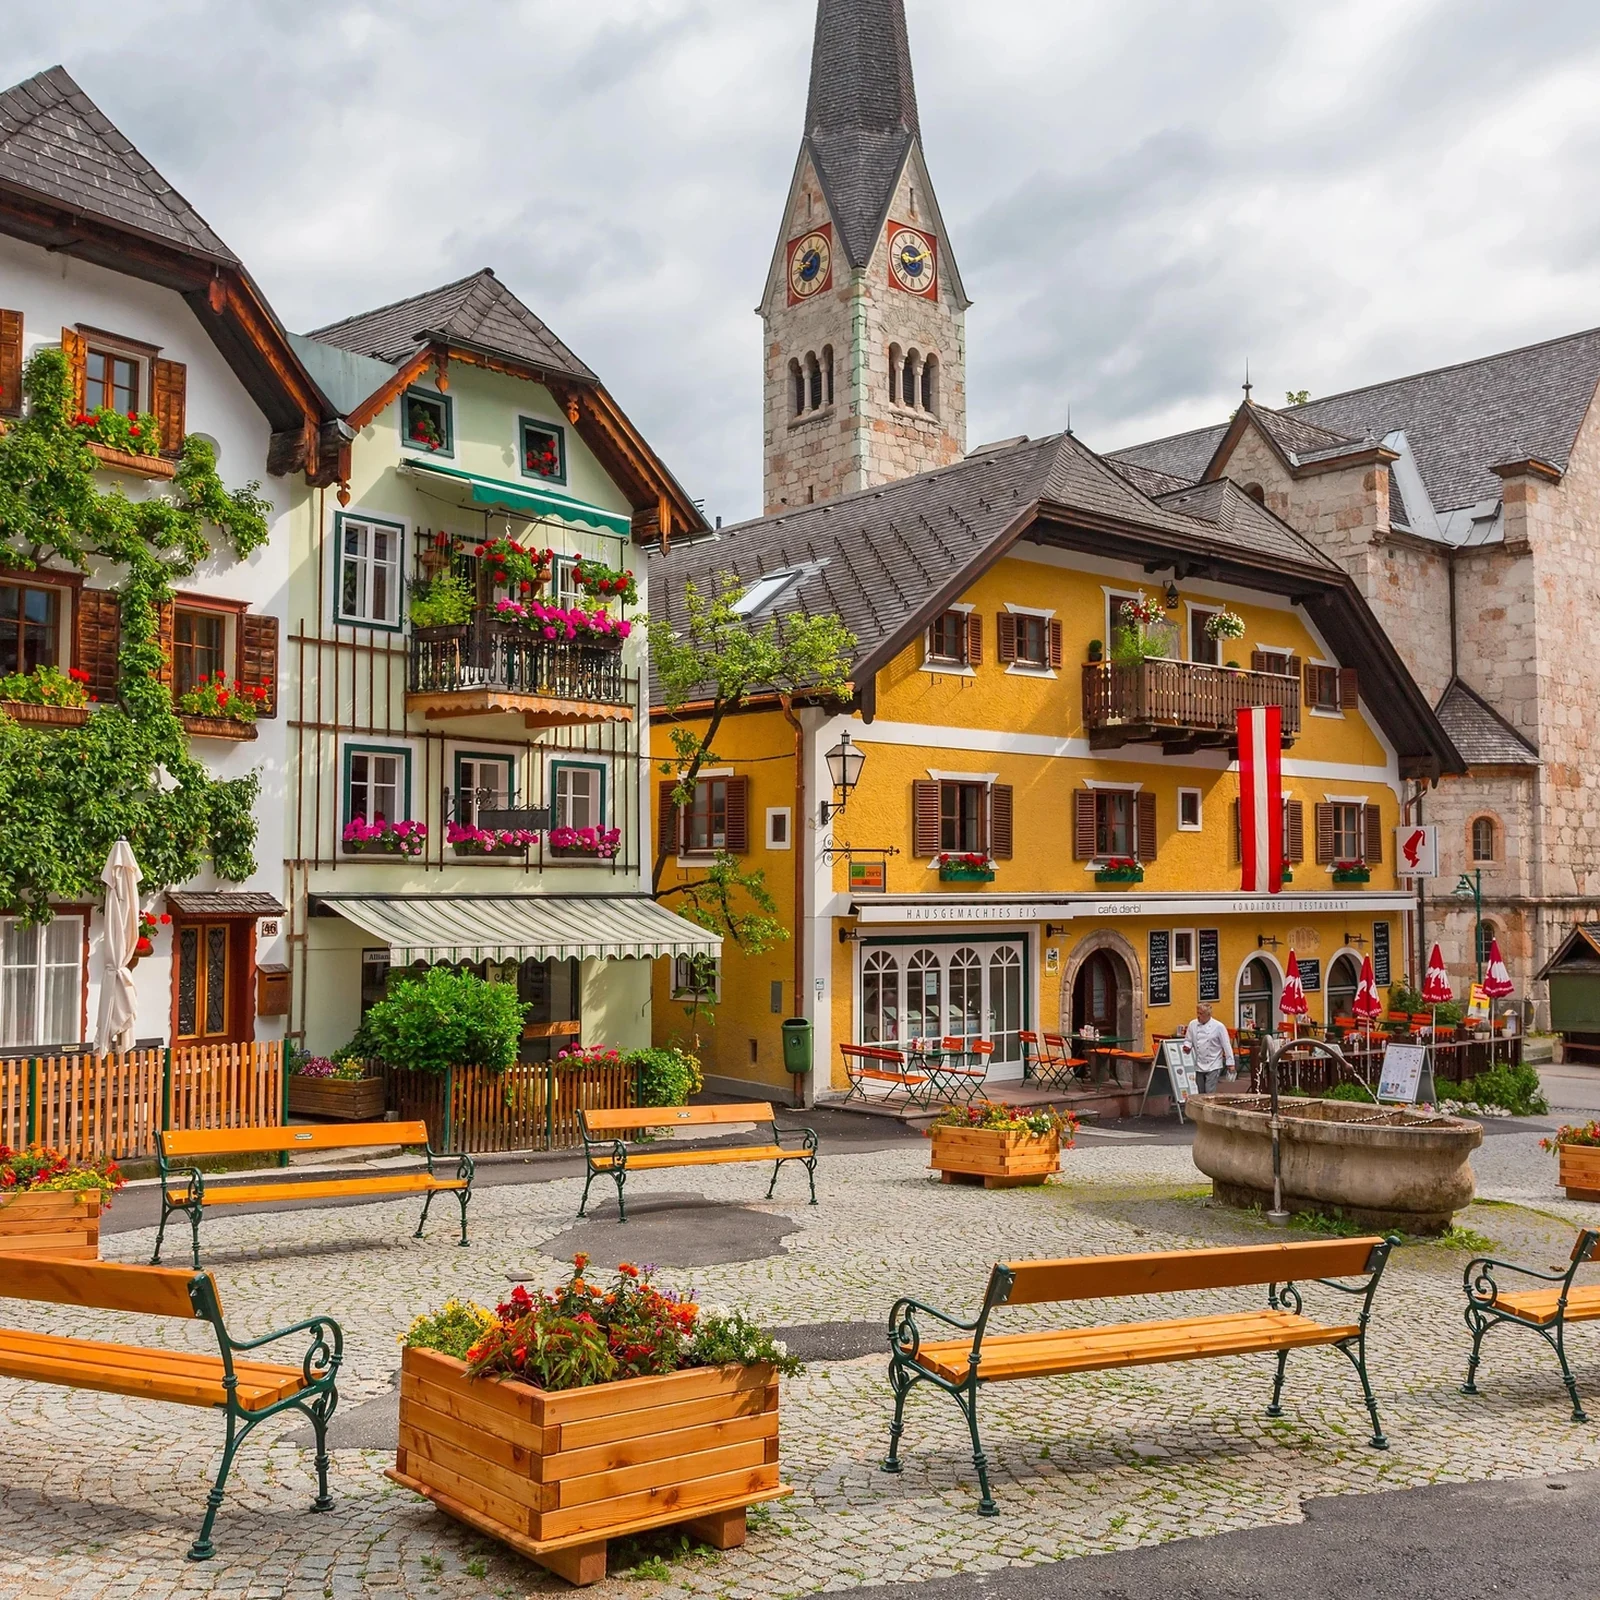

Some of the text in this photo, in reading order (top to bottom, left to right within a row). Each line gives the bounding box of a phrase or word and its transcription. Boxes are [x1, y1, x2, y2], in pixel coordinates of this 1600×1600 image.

[1233, 902, 1349, 911] KONDITOREI RESTAURANT
[907, 908, 1037, 919] HAUSGEMACHTES EIS
[264, 923, 276, 935] 46
